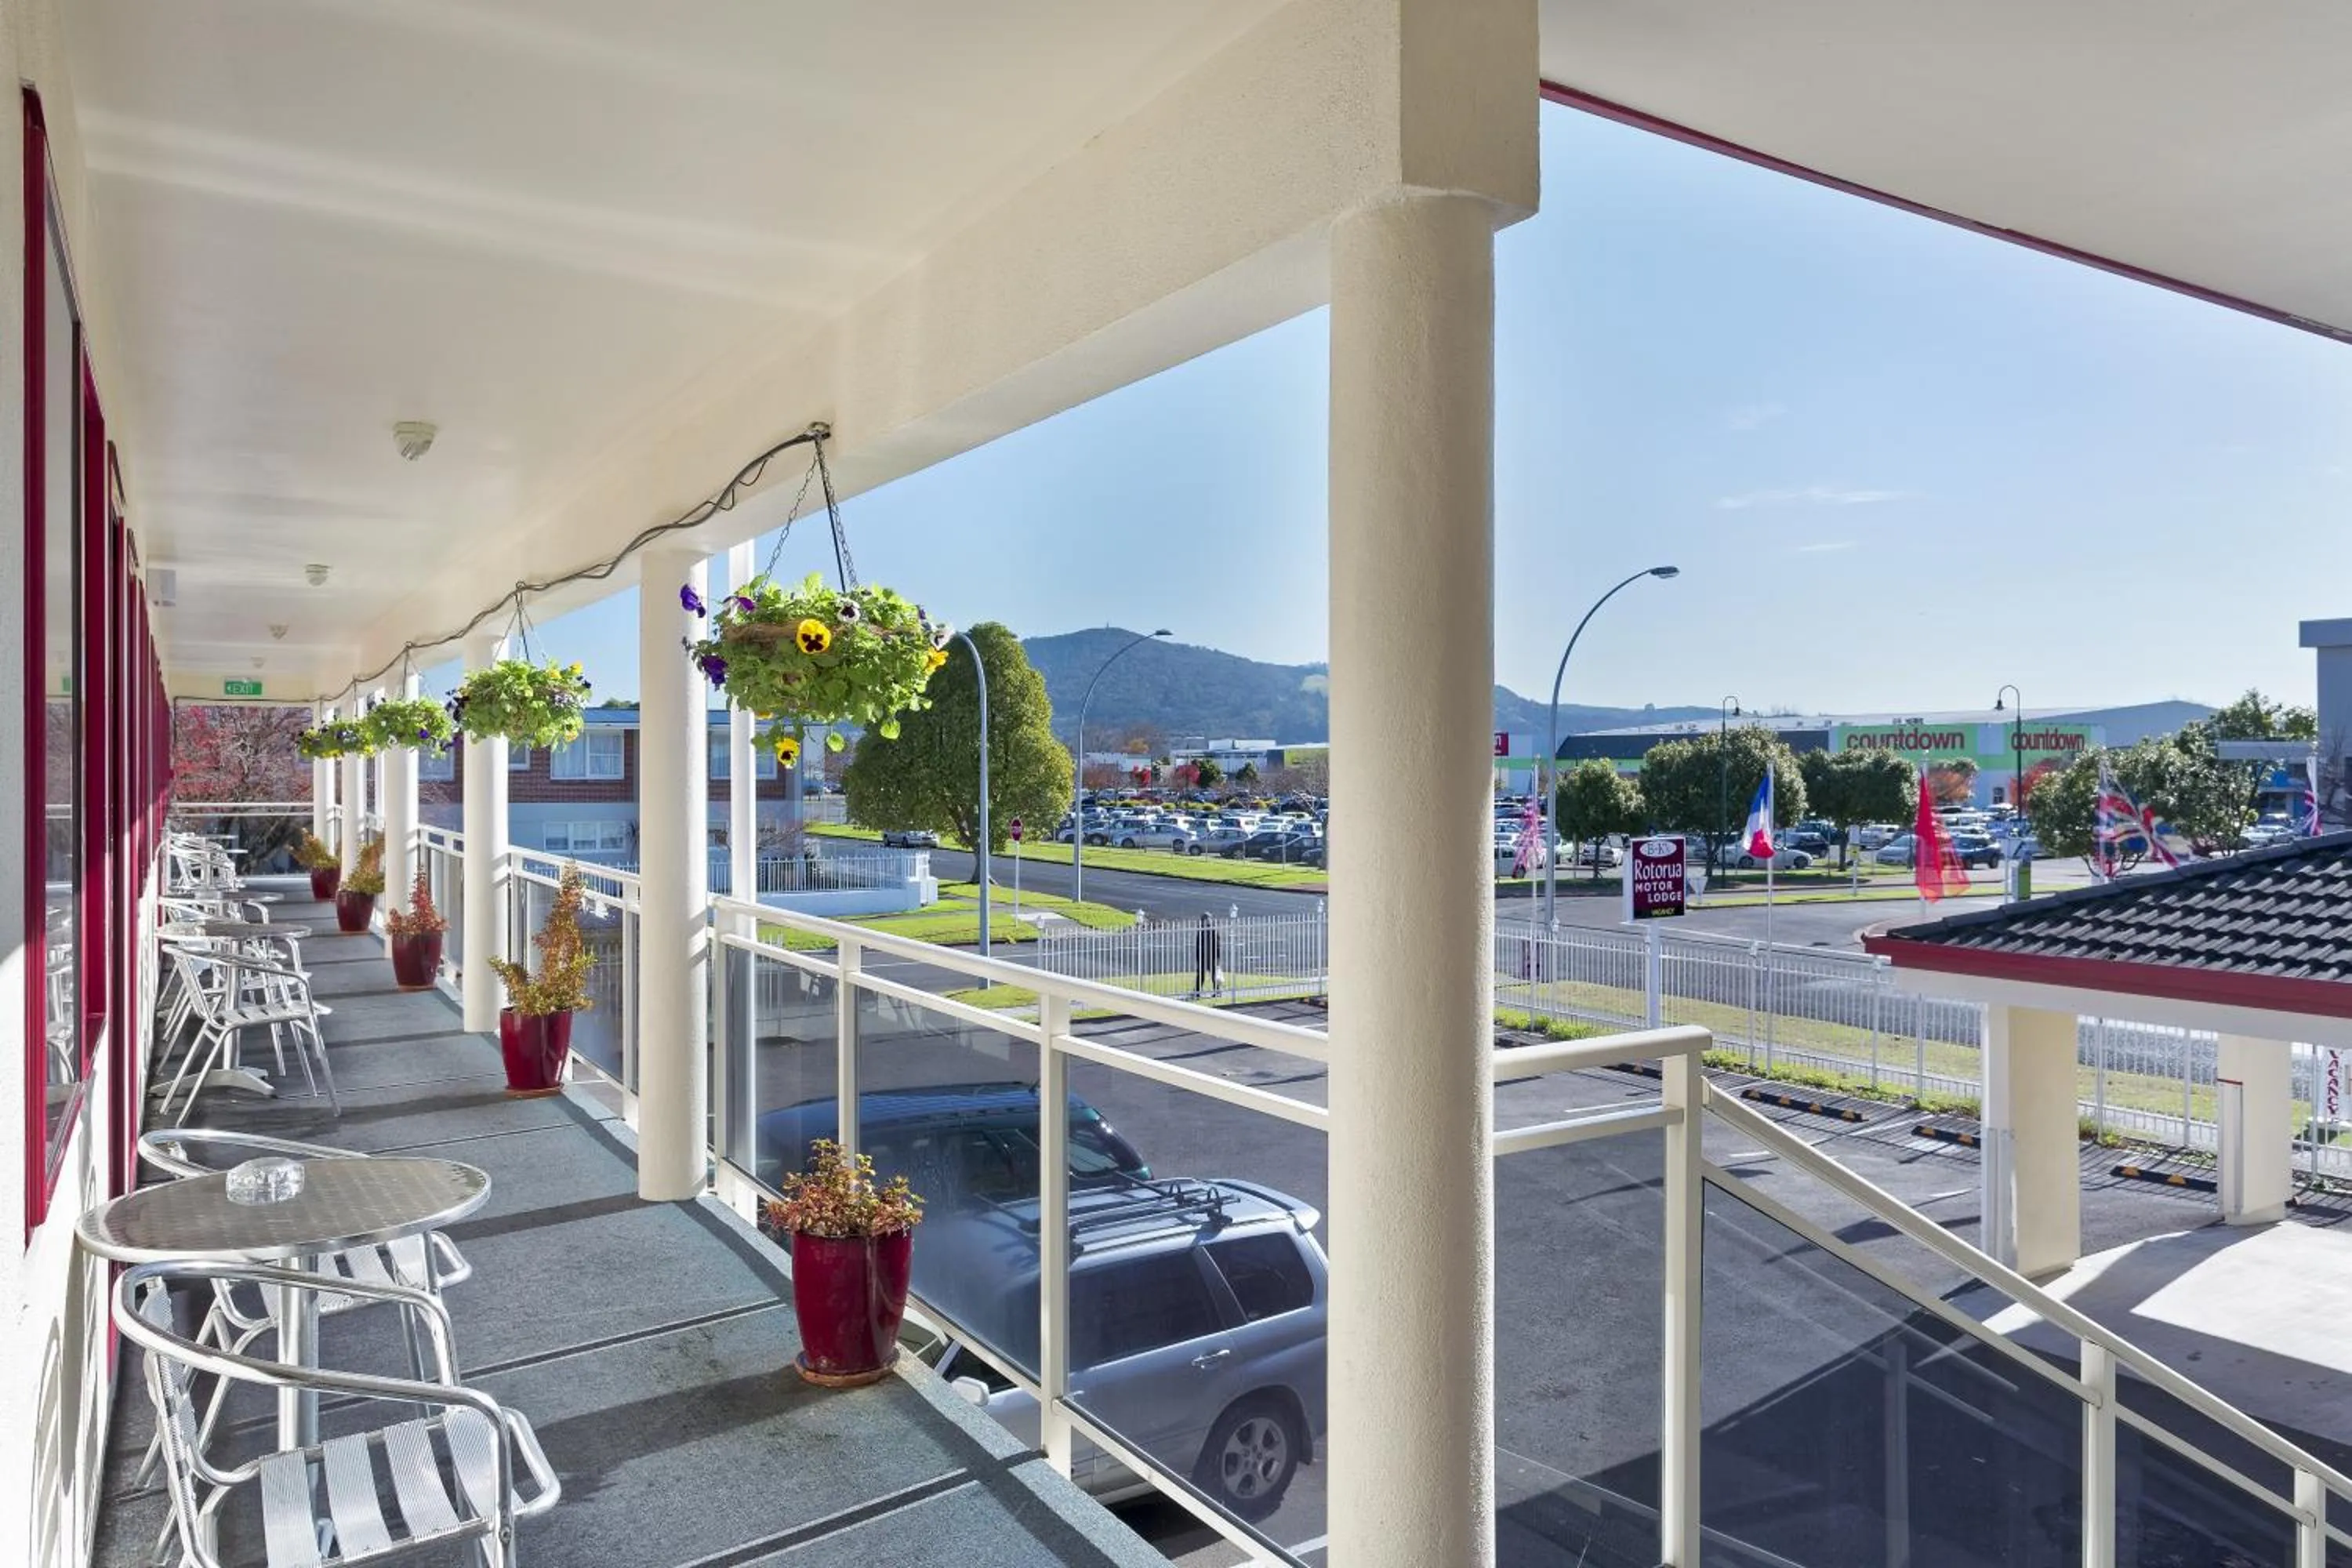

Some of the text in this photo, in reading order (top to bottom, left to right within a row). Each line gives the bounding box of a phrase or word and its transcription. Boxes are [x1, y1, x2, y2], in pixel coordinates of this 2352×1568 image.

[232, 683, 253, 694] EXIT
[1846, 728, 1965, 750] countdown
[2011, 728, 2085, 750] countdown
[1635, 859, 1682, 880] Rotorua
[1635, 881, 1673, 892] MOTOR
[1647, 891, 1682, 902] LODGE
